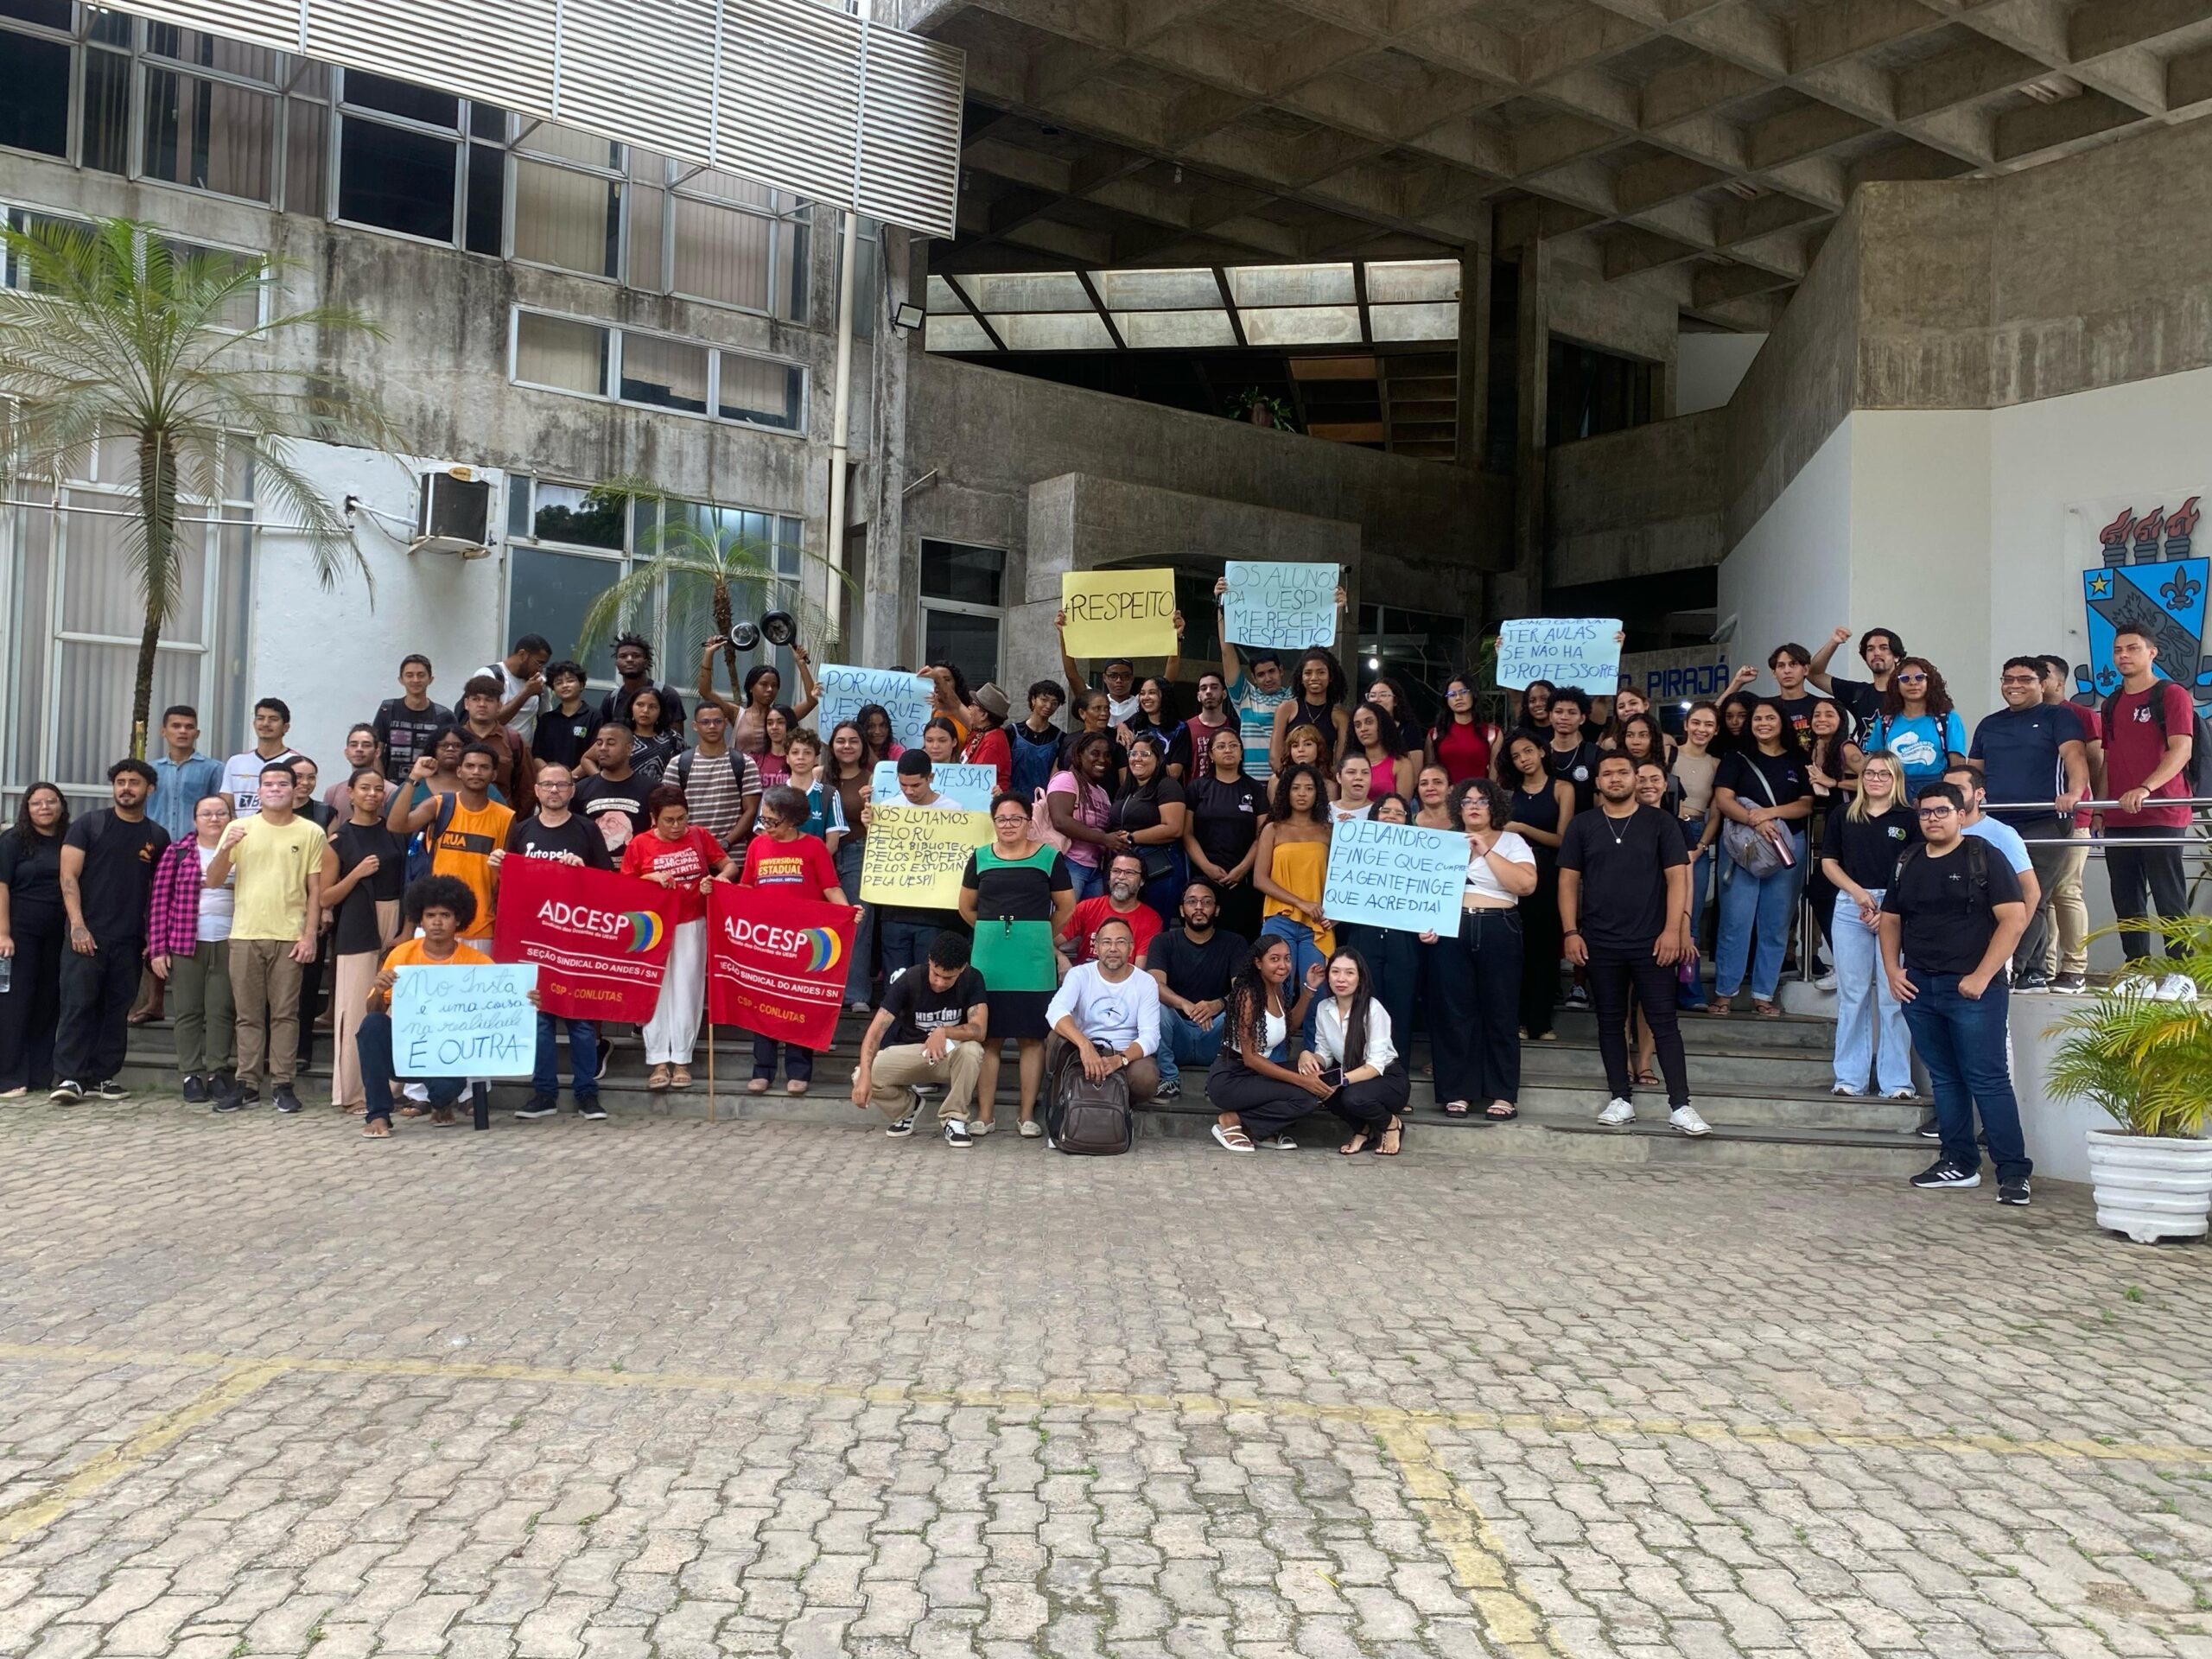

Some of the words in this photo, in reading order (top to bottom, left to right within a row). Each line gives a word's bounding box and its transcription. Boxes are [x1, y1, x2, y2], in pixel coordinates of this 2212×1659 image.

[1229, 564, 1261, 588] OS
[1263, 567, 1338, 591] ALUNOS
[1226, 590, 1245, 606] DA
[1265, 589, 1323, 610] UESPI
[1234, 610, 1332, 629] MERECEM
[1237, 626, 1332, 648] RESPEITO
[1506, 627, 1539, 643] TER
[1544, 625, 1597, 642] AULAS
[1502, 645, 1525, 660] SE
[1530, 642, 1559, 658] NÃO
[1563, 641, 1587, 659] HÁ
[1503, 663, 1618, 680] PROFESSORES
[1647, 655, 1729, 699] PIRAJÁ
[826, 670, 867, 695] POR
[870, 676, 914, 698] UMA
[884, 700, 924, 720] QUE
[932, 767, 992, 791] MESSAS
[872, 805, 900, 823] NÓS
[869, 823, 910, 841] PELO
[913, 827, 935, 842] RU
[1339, 821, 1357, 842] O
[1358, 822, 1441, 849] EVANDRO
[866, 849, 910, 862] PELOS
[868, 836, 904, 850] PELA
[909, 842, 975, 854] BIBLIOTECA
[758, 865, 802, 876] ESTADUAL
[865, 863, 906, 874] PELOS
[911, 861, 967, 873] ESTUDAN
[1332, 846, 1390, 867] FINGE
[1395, 853, 1433, 873] QUE
[864, 875, 894, 887] PELA
[1330, 867, 1340, 880] E
[1356, 871, 1406, 890] GENTE
[1406, 878, 1454, 896] FINGE
[1325, 888, 1360, 906] QUE
[1364, 893, 1440, 914] ACREDITA!
[537, 899, 629, 935] ADCESP
[724, 916, 808, 952] ADCESP
[527, 948, 556, 963] SEÇÃO
[556, 957, 593, 969] SINDICAL
[595, 963, 609, 971] DO
[609, 963, 640, 976] ANDES
[640, 968, 645, 976] /
[645, 969, 658, 978] SN
[397, 969, 454, 998] No
[460, 967, 518, 995] Insta
[550, 982, 567, 995] CSP
[574, 988, 622, 1002] CONLUTAS
[740, 971, 776, 988] SINDICAL
[778, 981, 790, 990] DO
[791, 983, 821, 995] ANDES
[821, 988, 825, 996] /
[416, 1001, 432, 1015] é
[439, 1002, 477, 1014] uma
[481, 999, 524, 1011] coisa
[737, 995, 753, 1007] CSP
[760, 1003, 805, 1023] CONLUTAS
[402, 1022, 433, 1035] na
[437, 1009, 524, 1033] realidade
[409, 1035, 428, 1069] É
[438, 1033, 528, 1065] OUTRA
